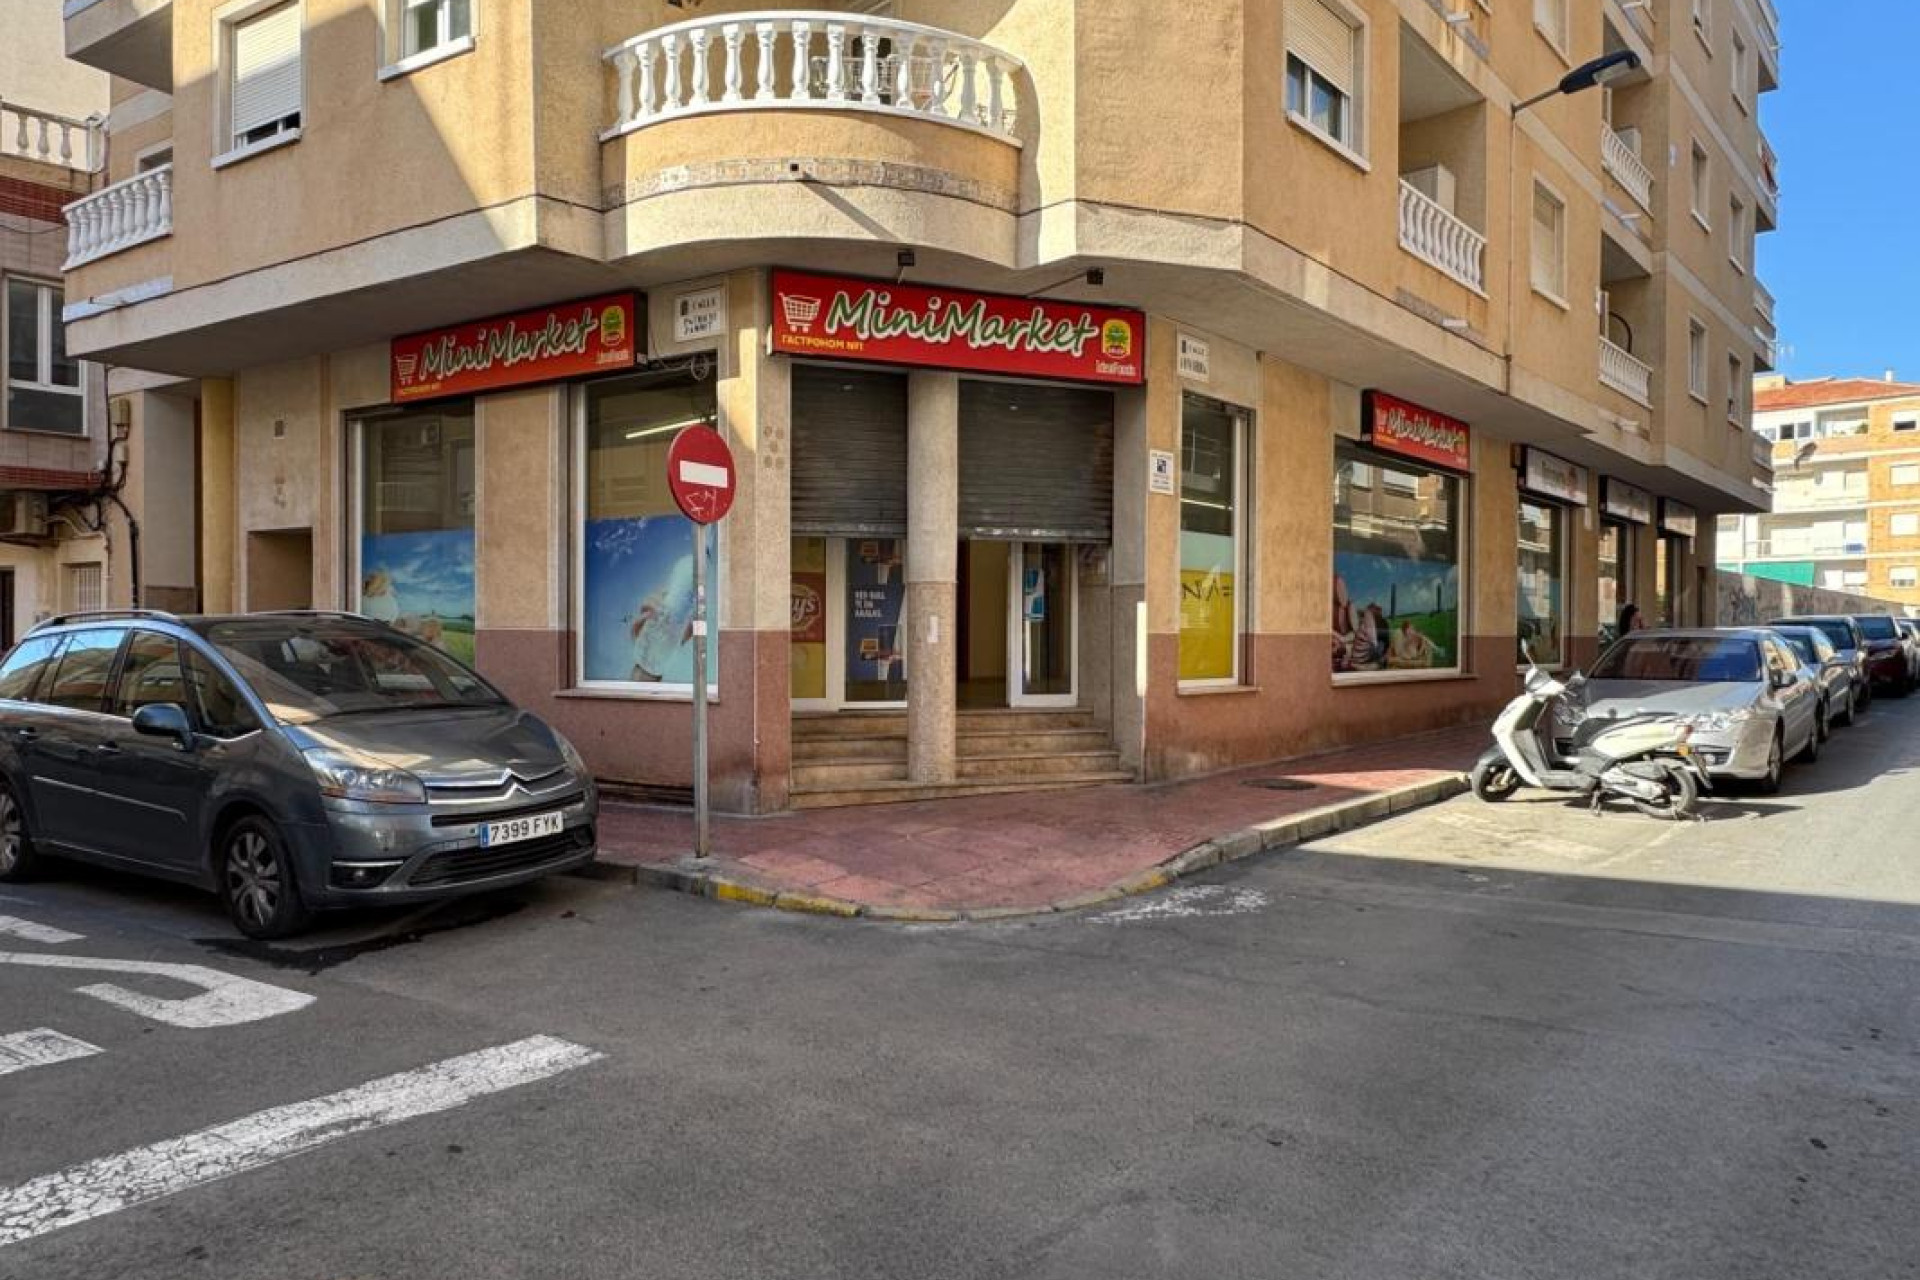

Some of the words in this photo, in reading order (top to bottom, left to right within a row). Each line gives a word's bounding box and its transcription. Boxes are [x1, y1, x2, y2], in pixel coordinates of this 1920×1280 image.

[419, 307, 599, 380] MiniMarket
[825, 290, 1099, 357] MiniMarket
[491, 820, 530, 842] 7399
[533, 815, 559, 834] FYK
